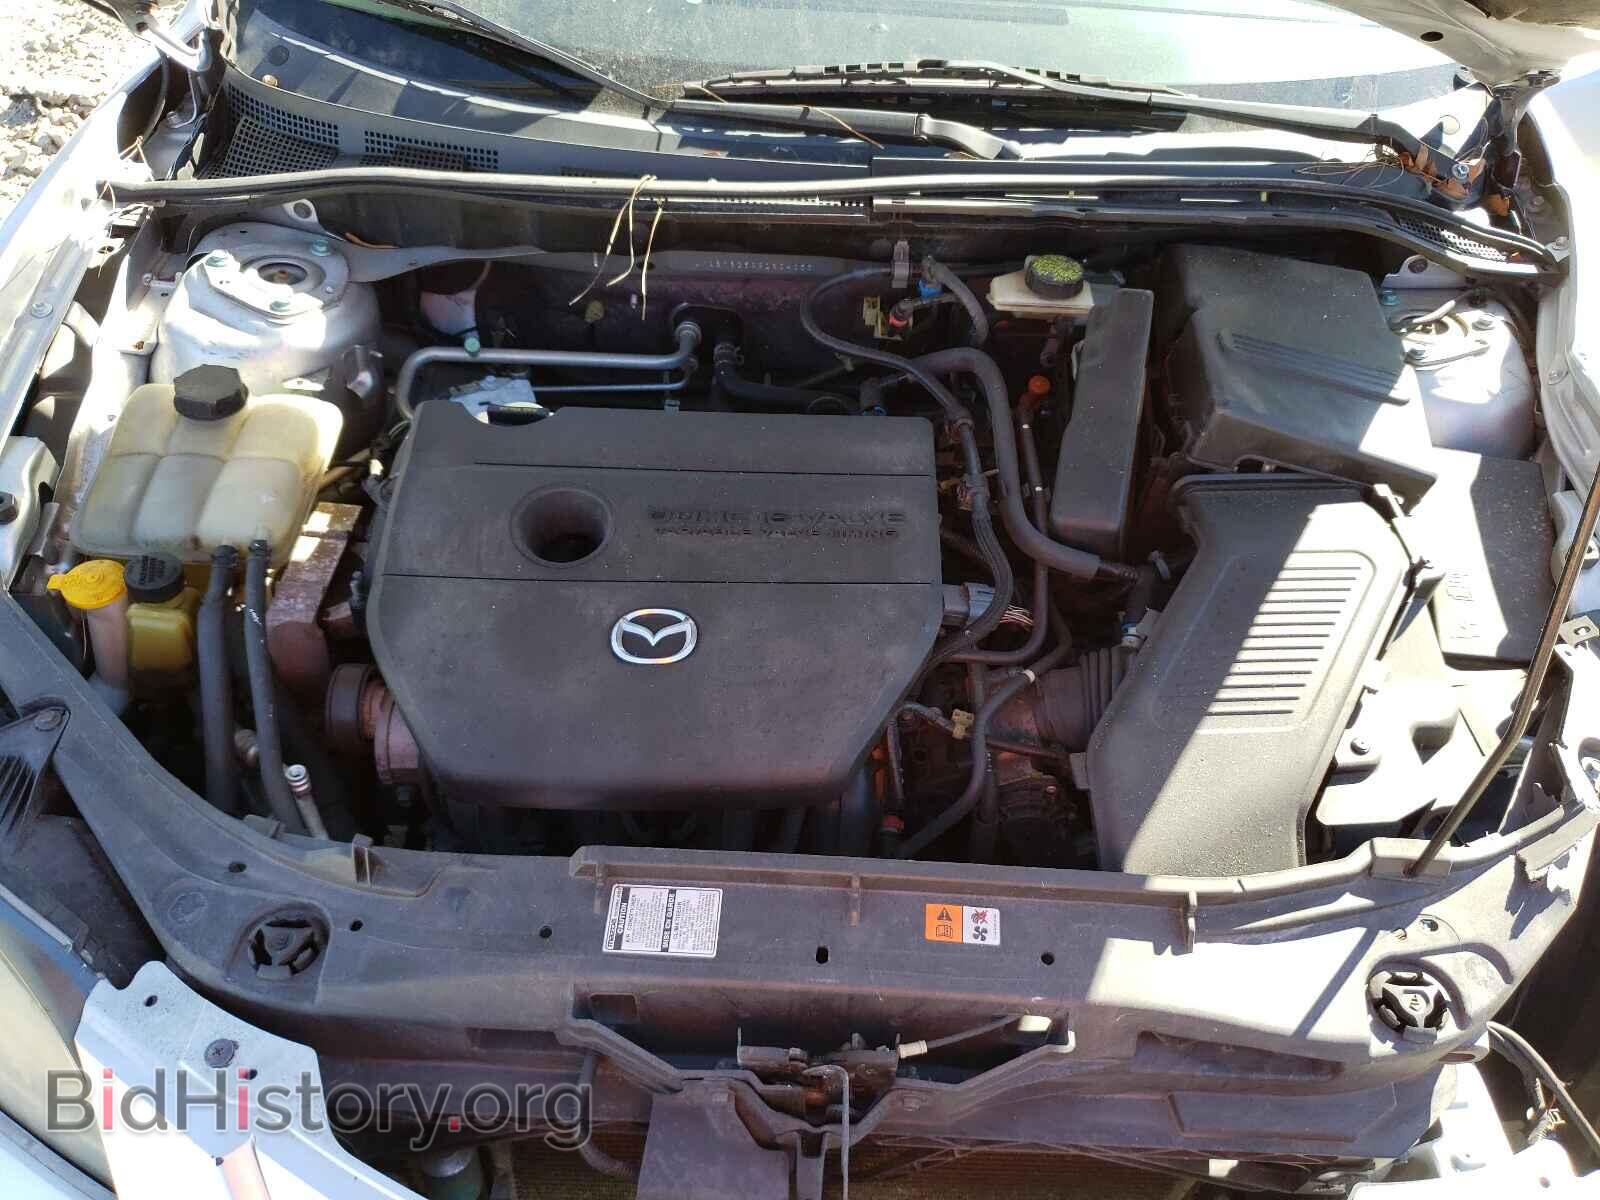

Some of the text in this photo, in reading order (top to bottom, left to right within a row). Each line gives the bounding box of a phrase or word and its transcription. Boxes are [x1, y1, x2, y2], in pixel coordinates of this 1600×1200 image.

[616, 902, 628, 934] CAUTION
[665, 893, 676, 918] GARDE
[662, 930, 671, 948] MISE
